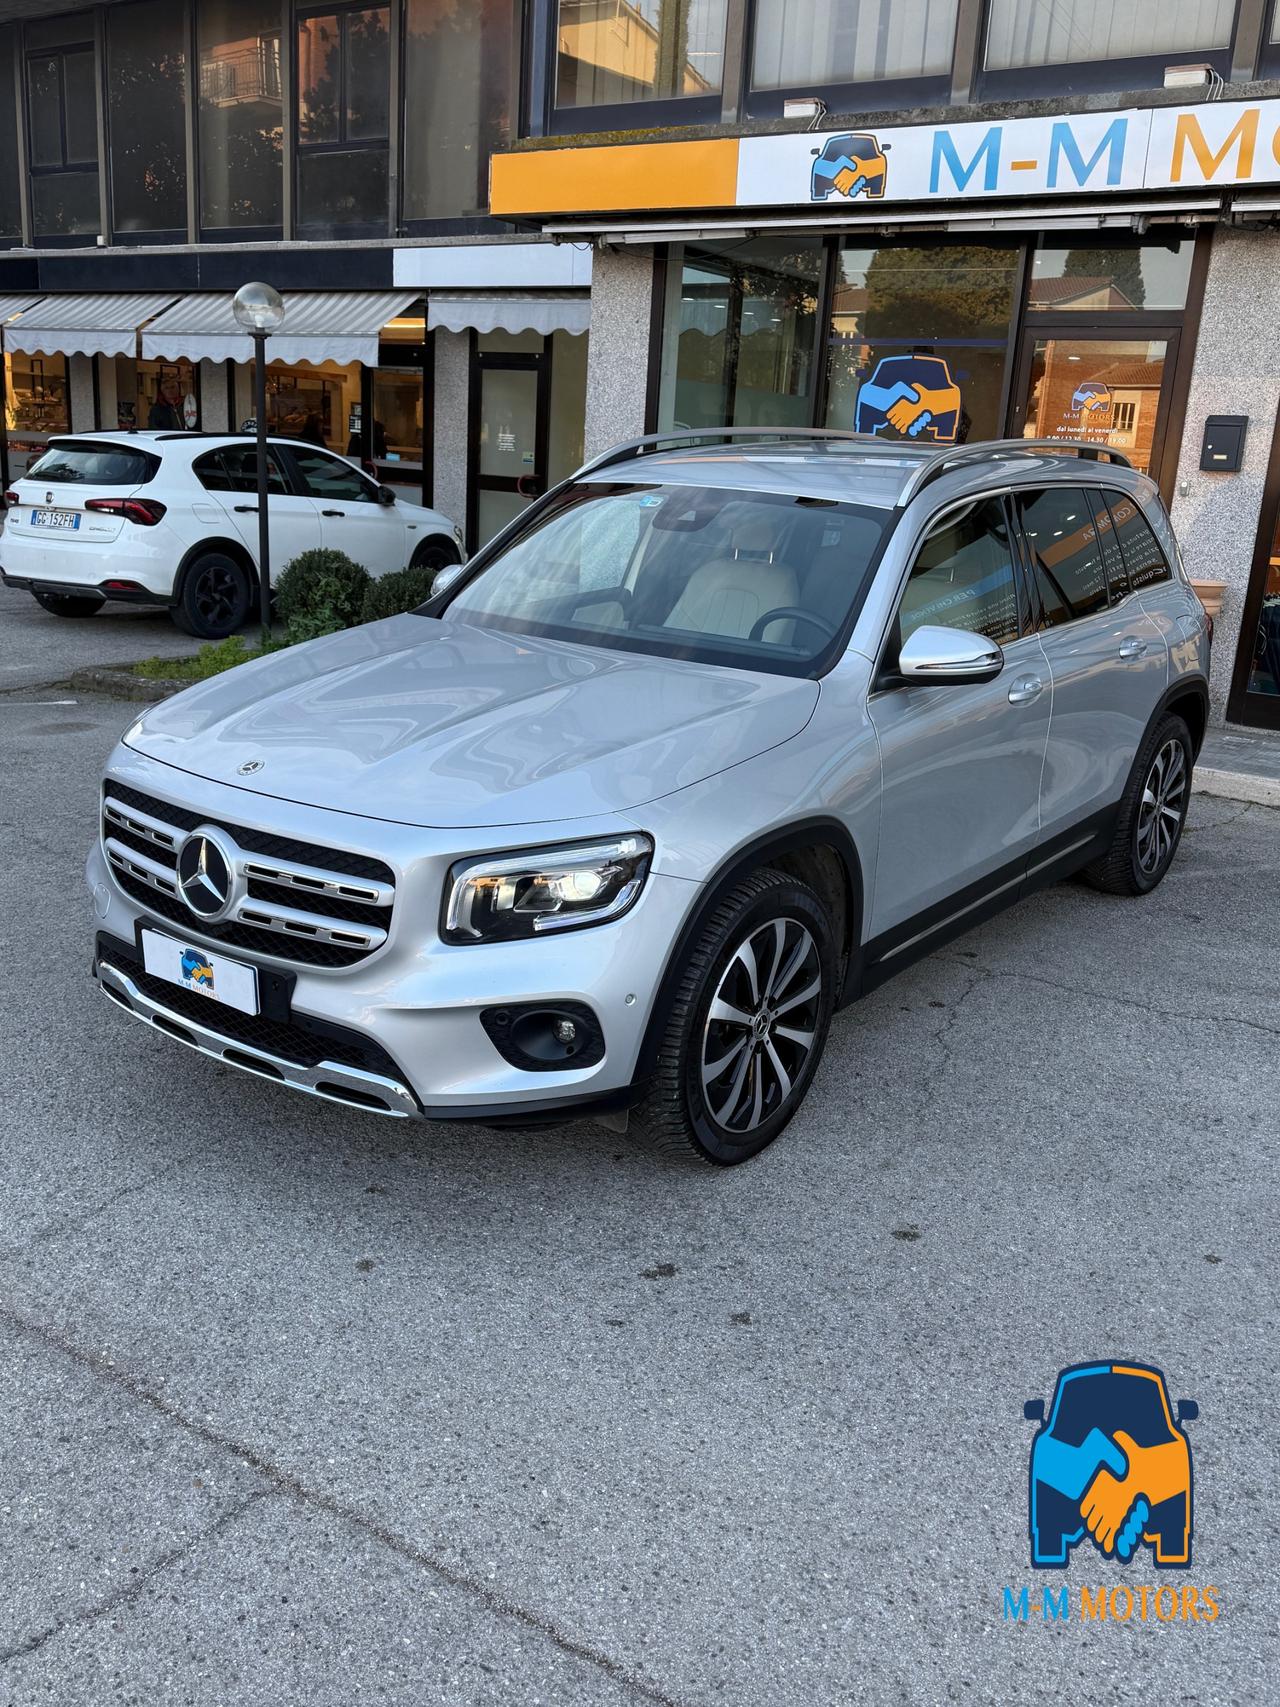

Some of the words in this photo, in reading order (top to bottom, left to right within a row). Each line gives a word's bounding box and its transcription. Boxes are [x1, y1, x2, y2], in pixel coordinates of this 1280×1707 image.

[929, 118, 1129, 193] M-M
[1170, 109, 1280, 183] M
[37, 512, 47, 524] GG
[49, 513, 75, 527] 152FH
